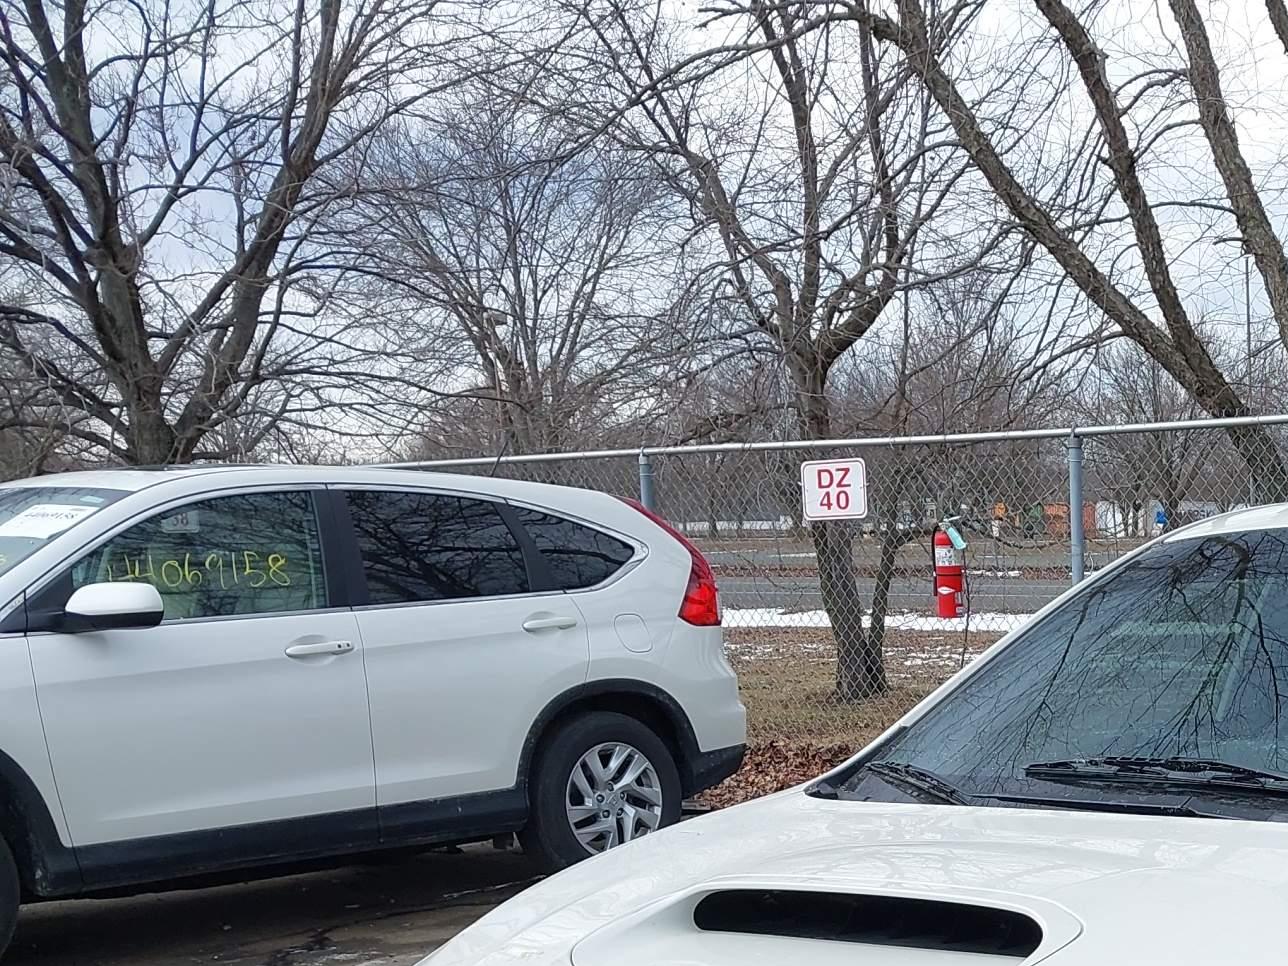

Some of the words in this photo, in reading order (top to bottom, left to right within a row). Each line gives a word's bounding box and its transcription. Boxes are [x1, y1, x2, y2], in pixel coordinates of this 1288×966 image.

[817, 467, 851, 489] DZ
[819, 490, 850, 511] 40
[107, 551, 291, 590] 44069158
